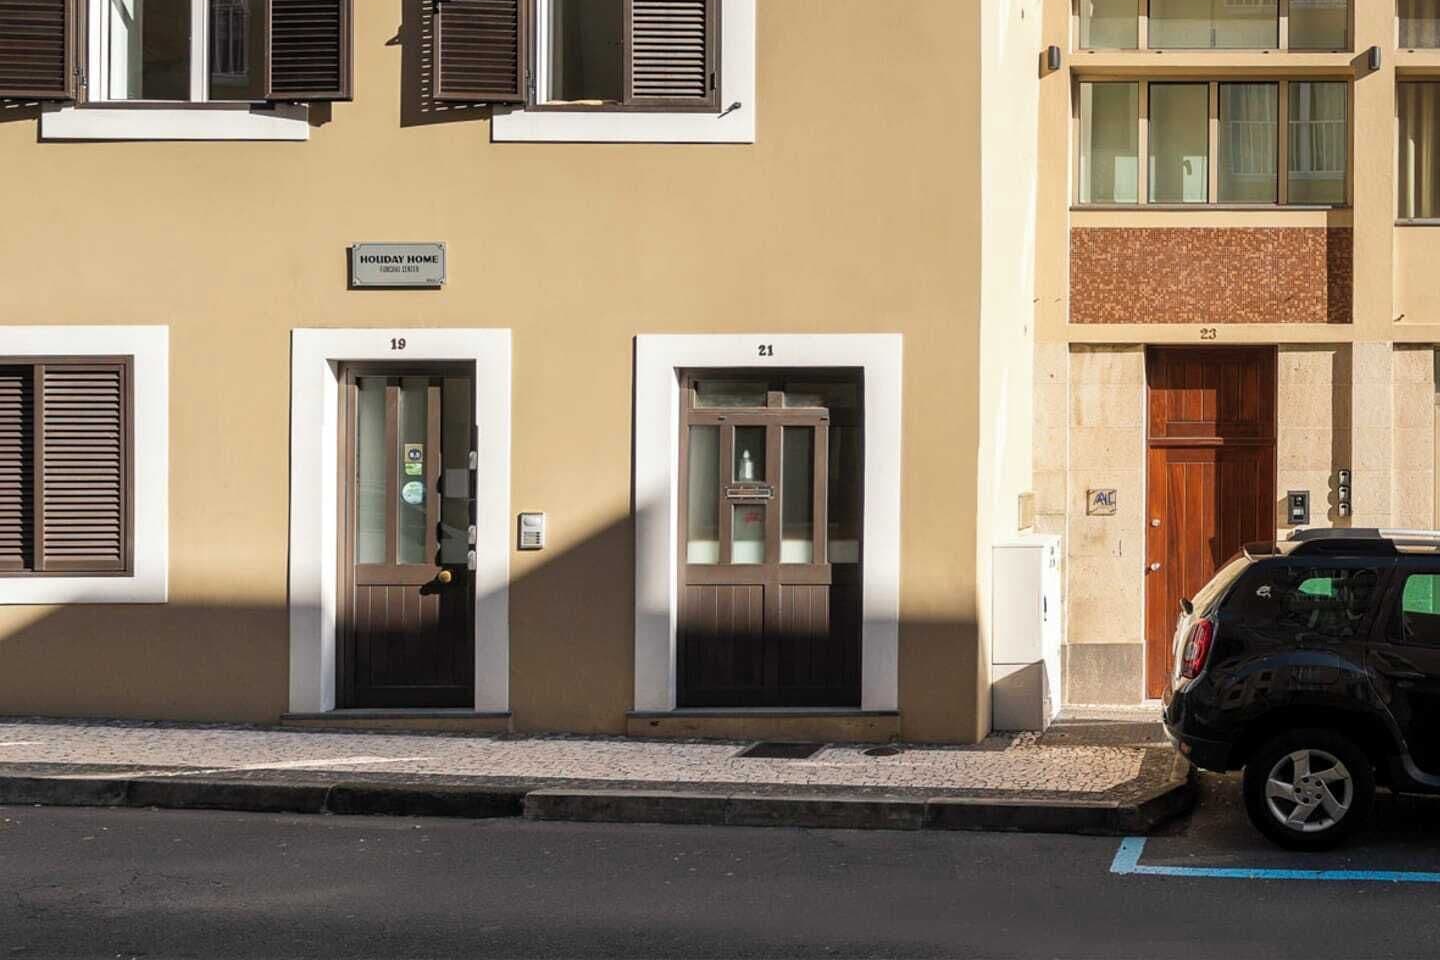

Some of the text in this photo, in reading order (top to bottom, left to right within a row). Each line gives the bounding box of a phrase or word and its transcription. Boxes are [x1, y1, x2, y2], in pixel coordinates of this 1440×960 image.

[360, 255, 439, 264] HOLIDAY HOME
[1200, 327, 1216, 339] 23
[390, 337, 406, 350] 19
[758, 344, 774, 356] 21
